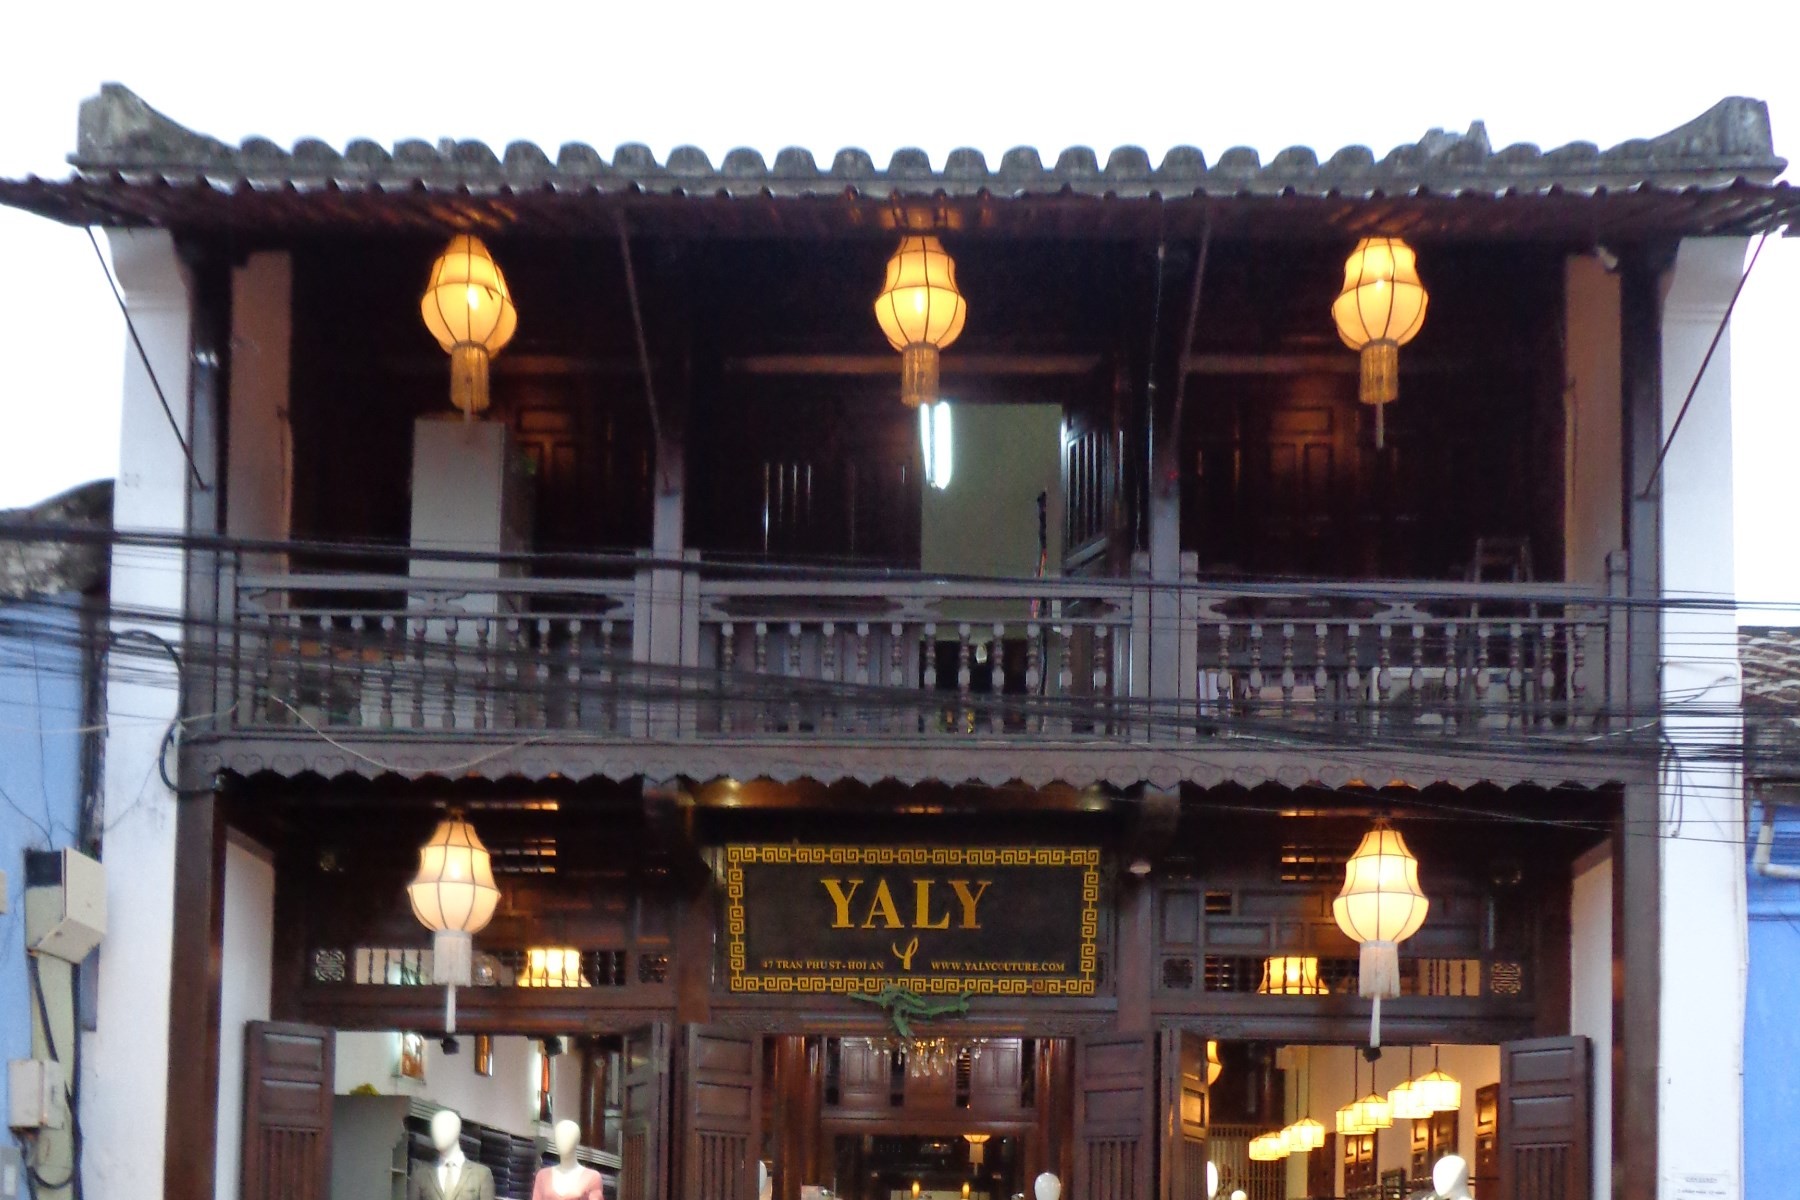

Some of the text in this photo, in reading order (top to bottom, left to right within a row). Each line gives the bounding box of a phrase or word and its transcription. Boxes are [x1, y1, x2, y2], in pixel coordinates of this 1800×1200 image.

[821, 878, 991, 930] YALY
[762, 959, 774, 969] 47
[776, 959, 803, 970] TRAN
[806, 960, 828, 970] PHU
[848, 960, 867, 970] HOI
[869, 960, 884, 970] AN
[931, 961, 1065, 972] WWW.YALYCOUTURE.COM
